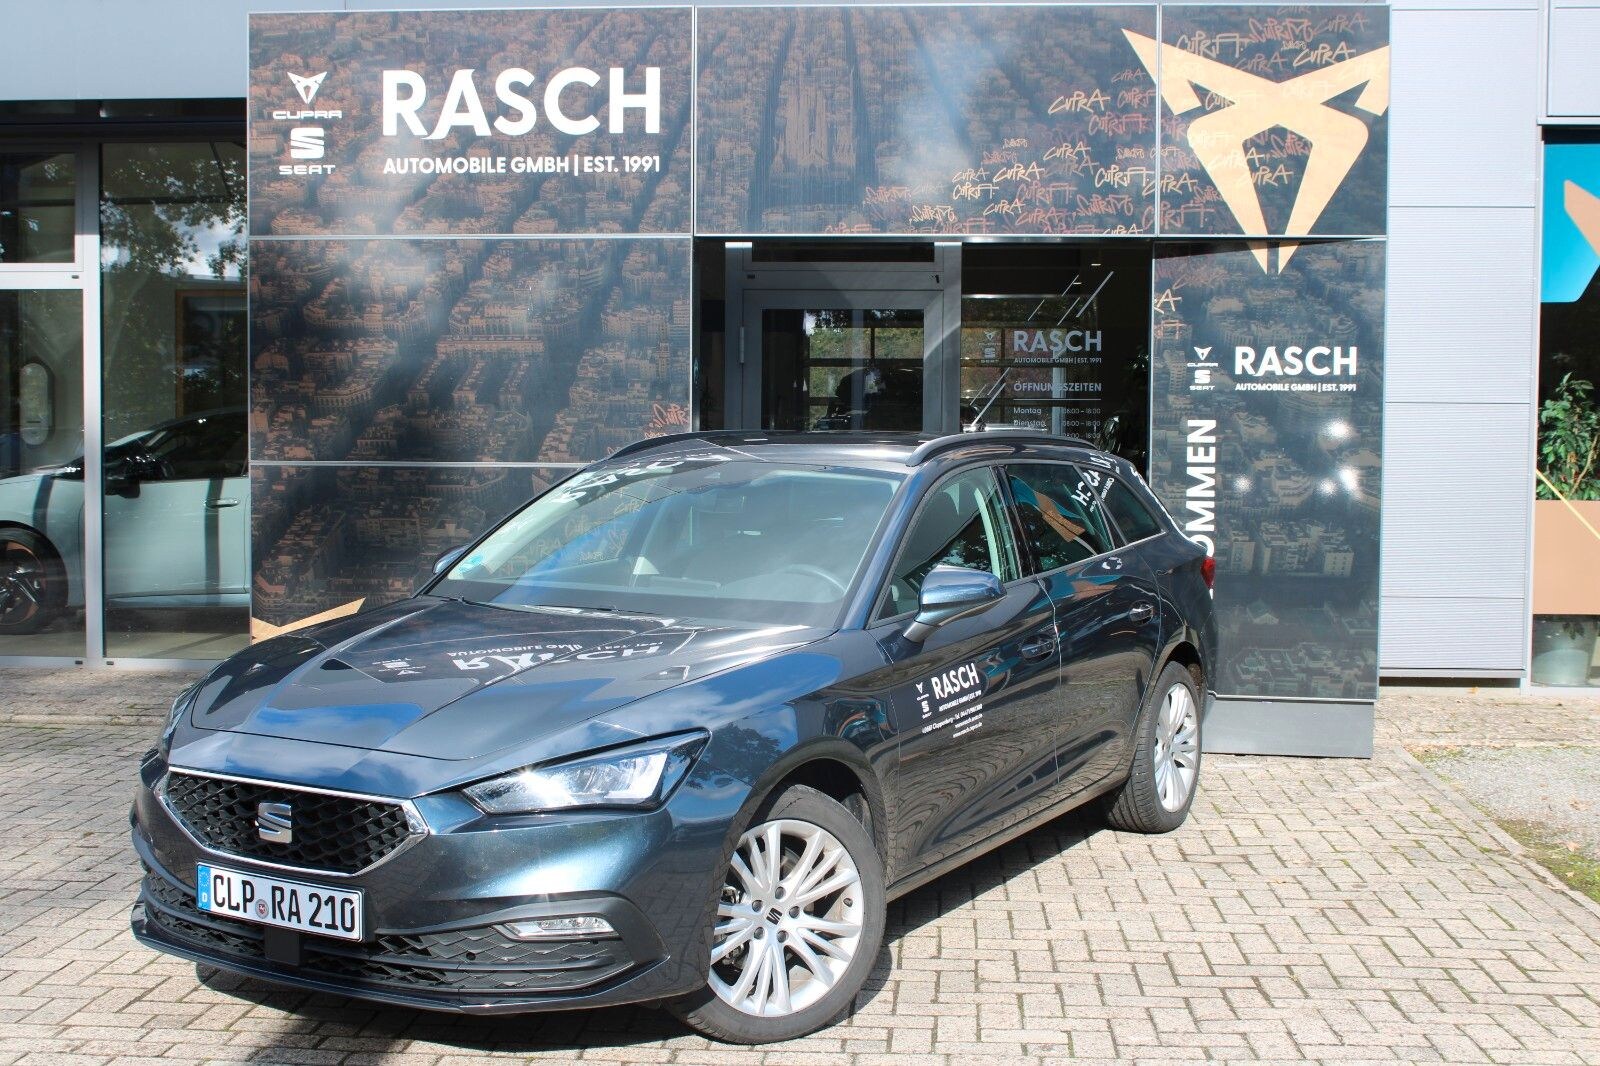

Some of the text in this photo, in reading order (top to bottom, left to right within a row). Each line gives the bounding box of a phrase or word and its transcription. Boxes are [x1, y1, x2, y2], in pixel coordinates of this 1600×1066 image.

[383, 67, 661, 140] RASCH
[272, 110, 342, 119] CUPRA
[279, 164, 336, 175] SEAT
[383, 157, 506, 174] AUTOMOBILE
[510, 156, 569, 173] GMBH
[584, 156, 619, 172] EST.
[623, 156, 660, 172] 1991
[1013, 330, 1102, 352] RASCH
[1234, 345, 1358, 377] RASCH
[1235, 382, 1290, 392] AUTOMOBILE
[1291, 382, 1317, 392] GMBH
[1322, 382, 1339, 392] EST.
[1339, 382, 1357, 392] 1991
[1013, 407, 1042, 415] Montag
[931, 662, 980, 699] RASCH
[213, 874, 355, 933] CLP RA 210
